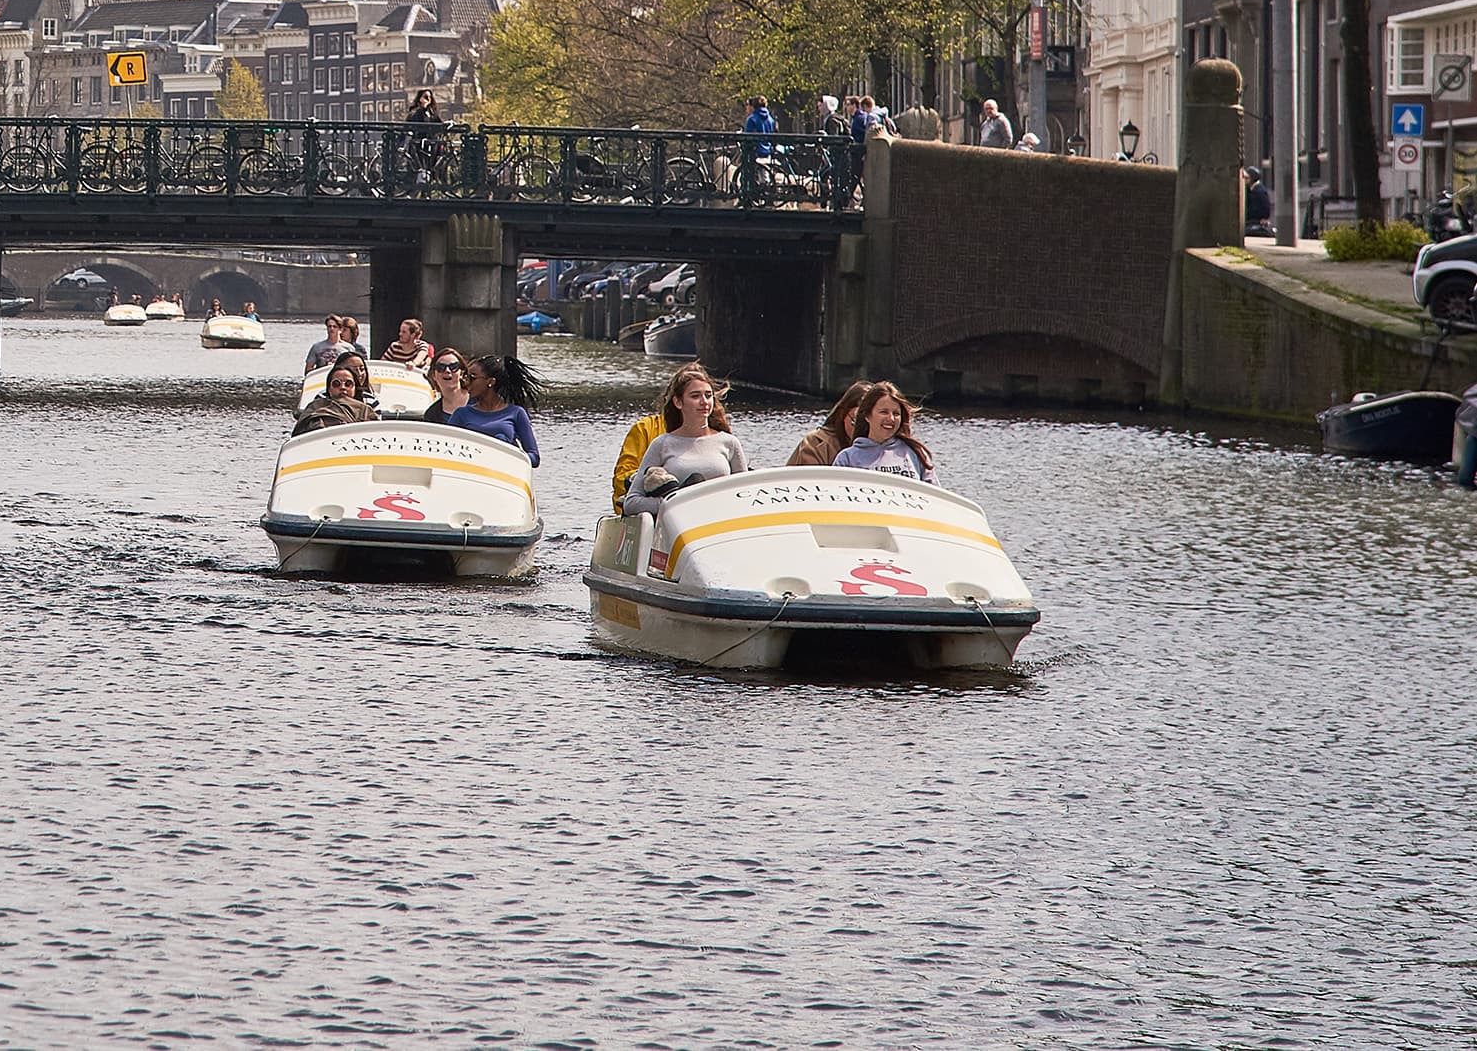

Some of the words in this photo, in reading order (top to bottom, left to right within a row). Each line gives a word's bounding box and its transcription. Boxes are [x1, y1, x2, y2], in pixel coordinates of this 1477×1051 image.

[127, 62, 135, 75] R
[331, 437, 402, 447] CANAL
[412, 438, 483, 454] TOURS
[337, 444, 474, 459] AMSTERDAM
[735, 485, 829, 499] CANAL
[838, 485, 931, 504] TOURS
[750, 495, 925, 511] AMSTERDAM
